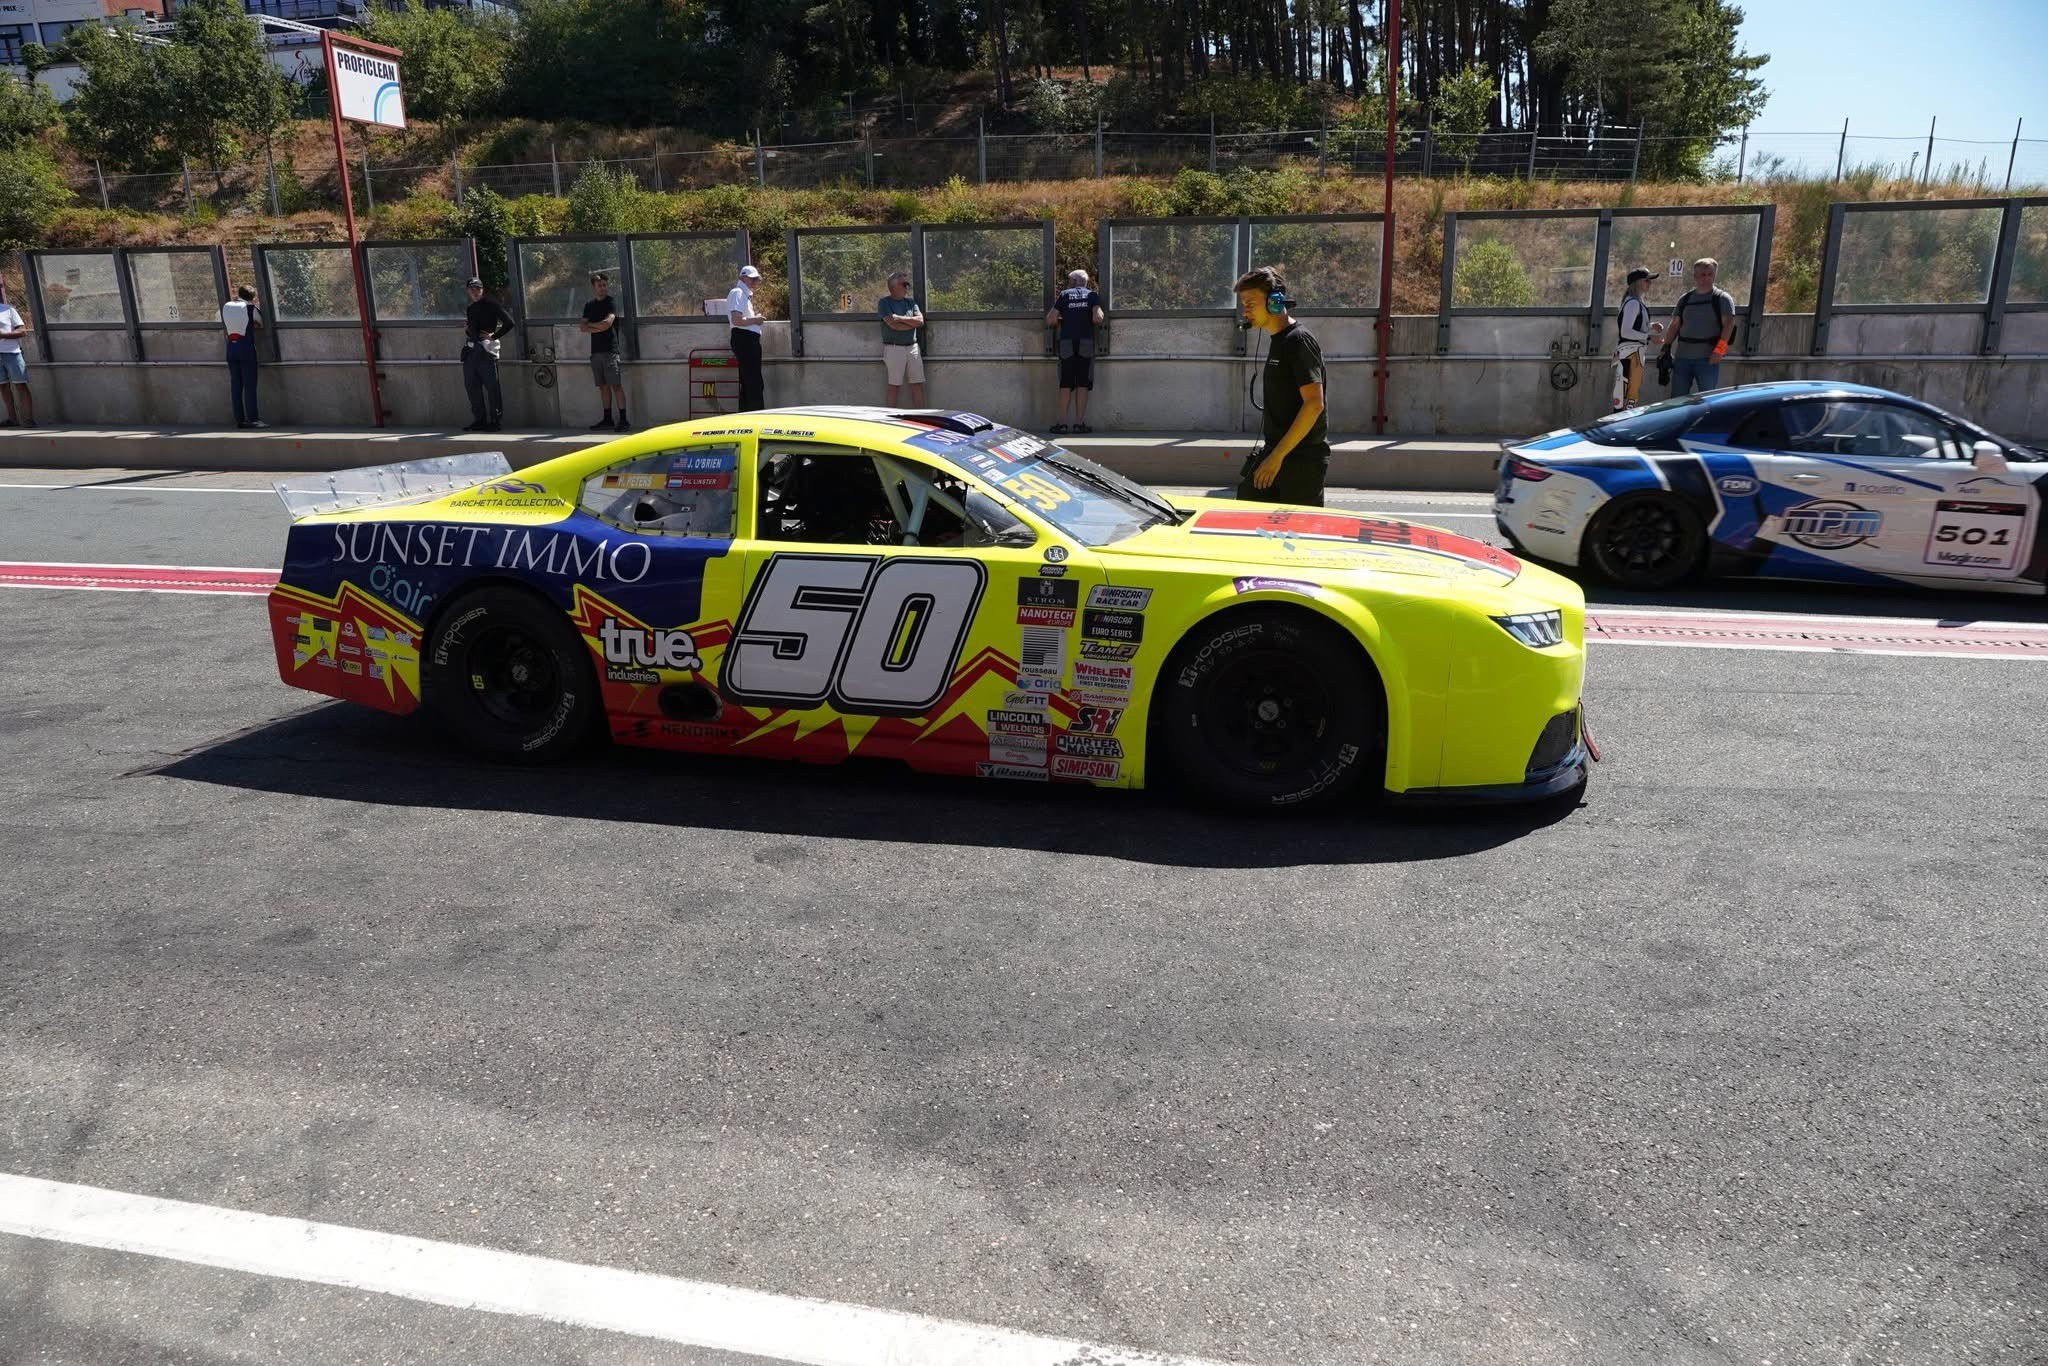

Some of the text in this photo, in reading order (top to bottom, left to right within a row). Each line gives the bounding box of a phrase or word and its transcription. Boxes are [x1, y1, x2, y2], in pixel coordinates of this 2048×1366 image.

[337, 52, 396, 81] PROFICLEAN
[1672, 259, 1683, 272] 10
[841, 294, 852, 307] 15
[703, 383, 715, 397] IN
[694, 458, 722, 469] O'BRIEN
[626, 476, 652, 487] PETERS
[1721, 479, 1753, 490] FDN
[1001, 472, 1072, 511] 50
[450, 498, 567, 508] BARCHETTA COLLECTION
[1935, 524, 2010, 546] 501
[332, 521, 652, 584] SUNSET IMMO
[1110, 588, 1143, 600] NASCAR
[1095, 598, 1139, 607] RACE CAR
[1020, 608, 1075, 621] NANOTECH
[1103, 615, 1133, 625] NASCAR
[439, 607, 489, 651] HOOSIER
[719, 551, 989, 717] 50
[1091, 626, 1133, 639] EURO SERIES
[1193, 623, 1264, 670] HOOSIER
[608, 668, 658, 684] industries
[1021, 666, 1059, 675] rousseau
[1075, 662, 1132, 678] WHELEN
[1107, 676, 1130, 685] PROTECT
[989, 711, 1041, 724] LINCOLN
[1001, 723, 1046, 734] WELDERS
[1057, 735, 1118, 748] QUARTER
[1067, 744, 1120, 757] MASTER
[1057, 758, 1116, 779] SIMPSON
